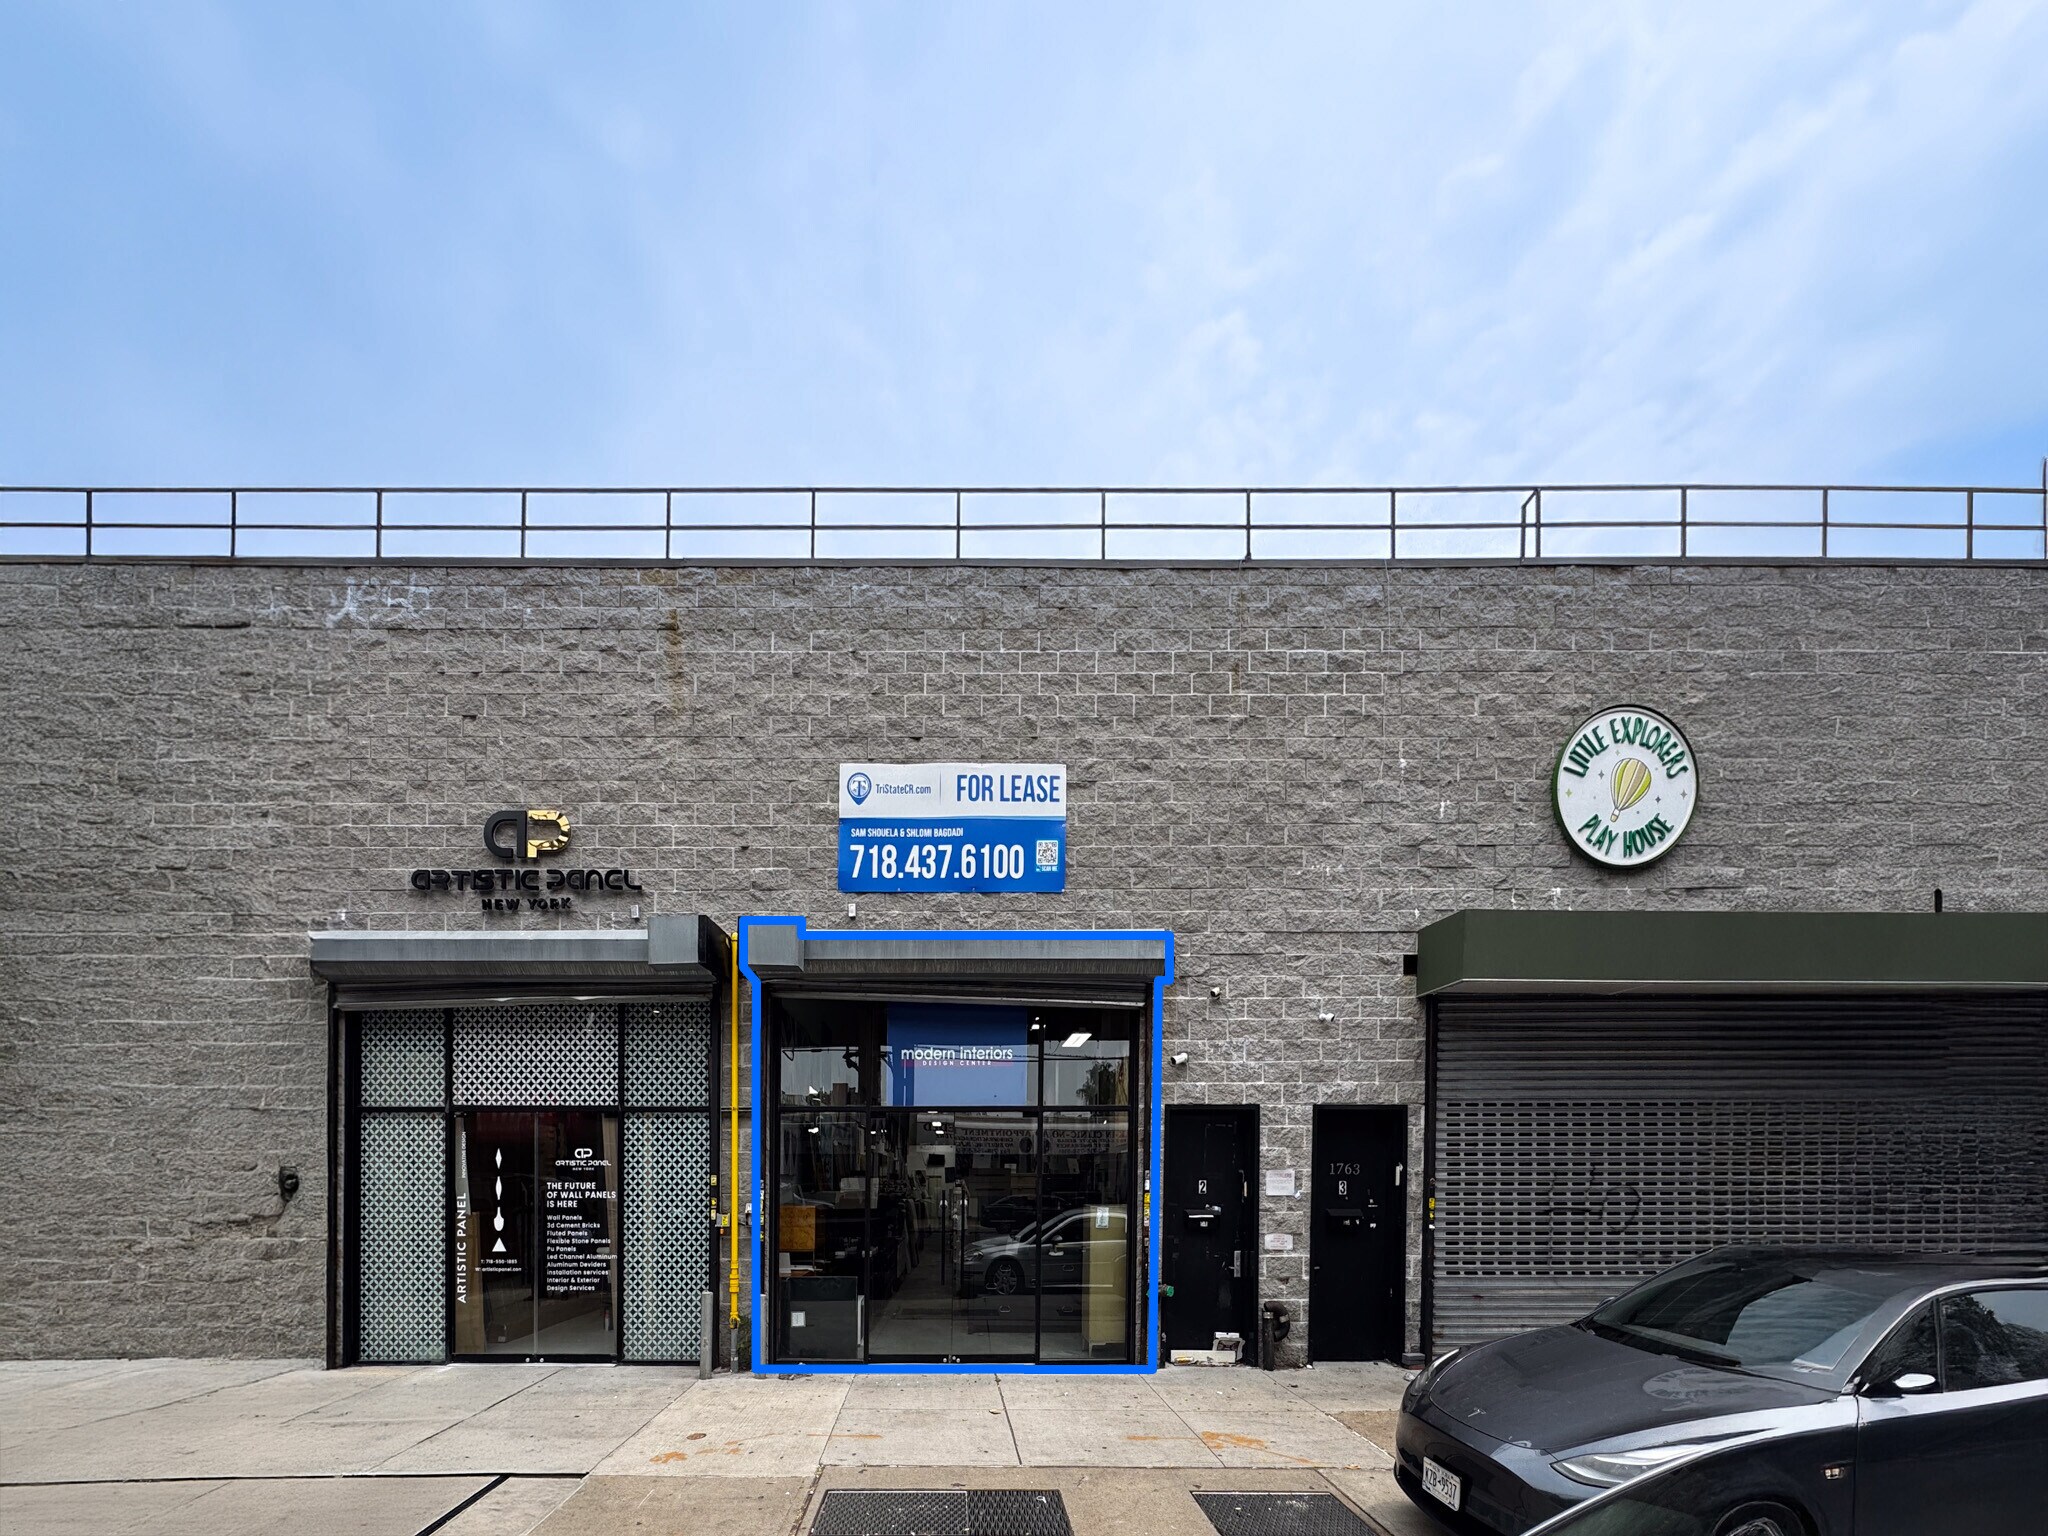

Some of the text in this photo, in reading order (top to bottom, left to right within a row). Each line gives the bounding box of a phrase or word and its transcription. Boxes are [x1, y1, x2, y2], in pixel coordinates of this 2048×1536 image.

[1563, 716, 1689, 779] LITTLE EXPLORERS
[875, 783, 932, 795] TriStateCR.com
[956, 774, 1061, 803] FOR LEASE
[850, 828, 866, 837] SAM
[899, 828, 905, 837] &
[906, 828, 933, 837] SHLOMI
[933, 827, 964, 837] BAGDADI
[1578, 813, 1675, 858] PLAY HOUSE
[850, 844, 1025, 879] 718.437.6100
[411, 869, 540, 891] ARTISTIC
[481, 897, 573, 911] NEW YORK
[901, 1046, 1013, 1060] modern interiors
[1329, 1163, 1360, 1175] 1763
[547, 1182, 596, 1190] THE FUTURE
[546, 1191, 617, 1199] OF WALL PANELS
[547, 1200, 578, 1208] IS HERE
[456, 1192, 467, 1303] ARTISTIC PANEL
